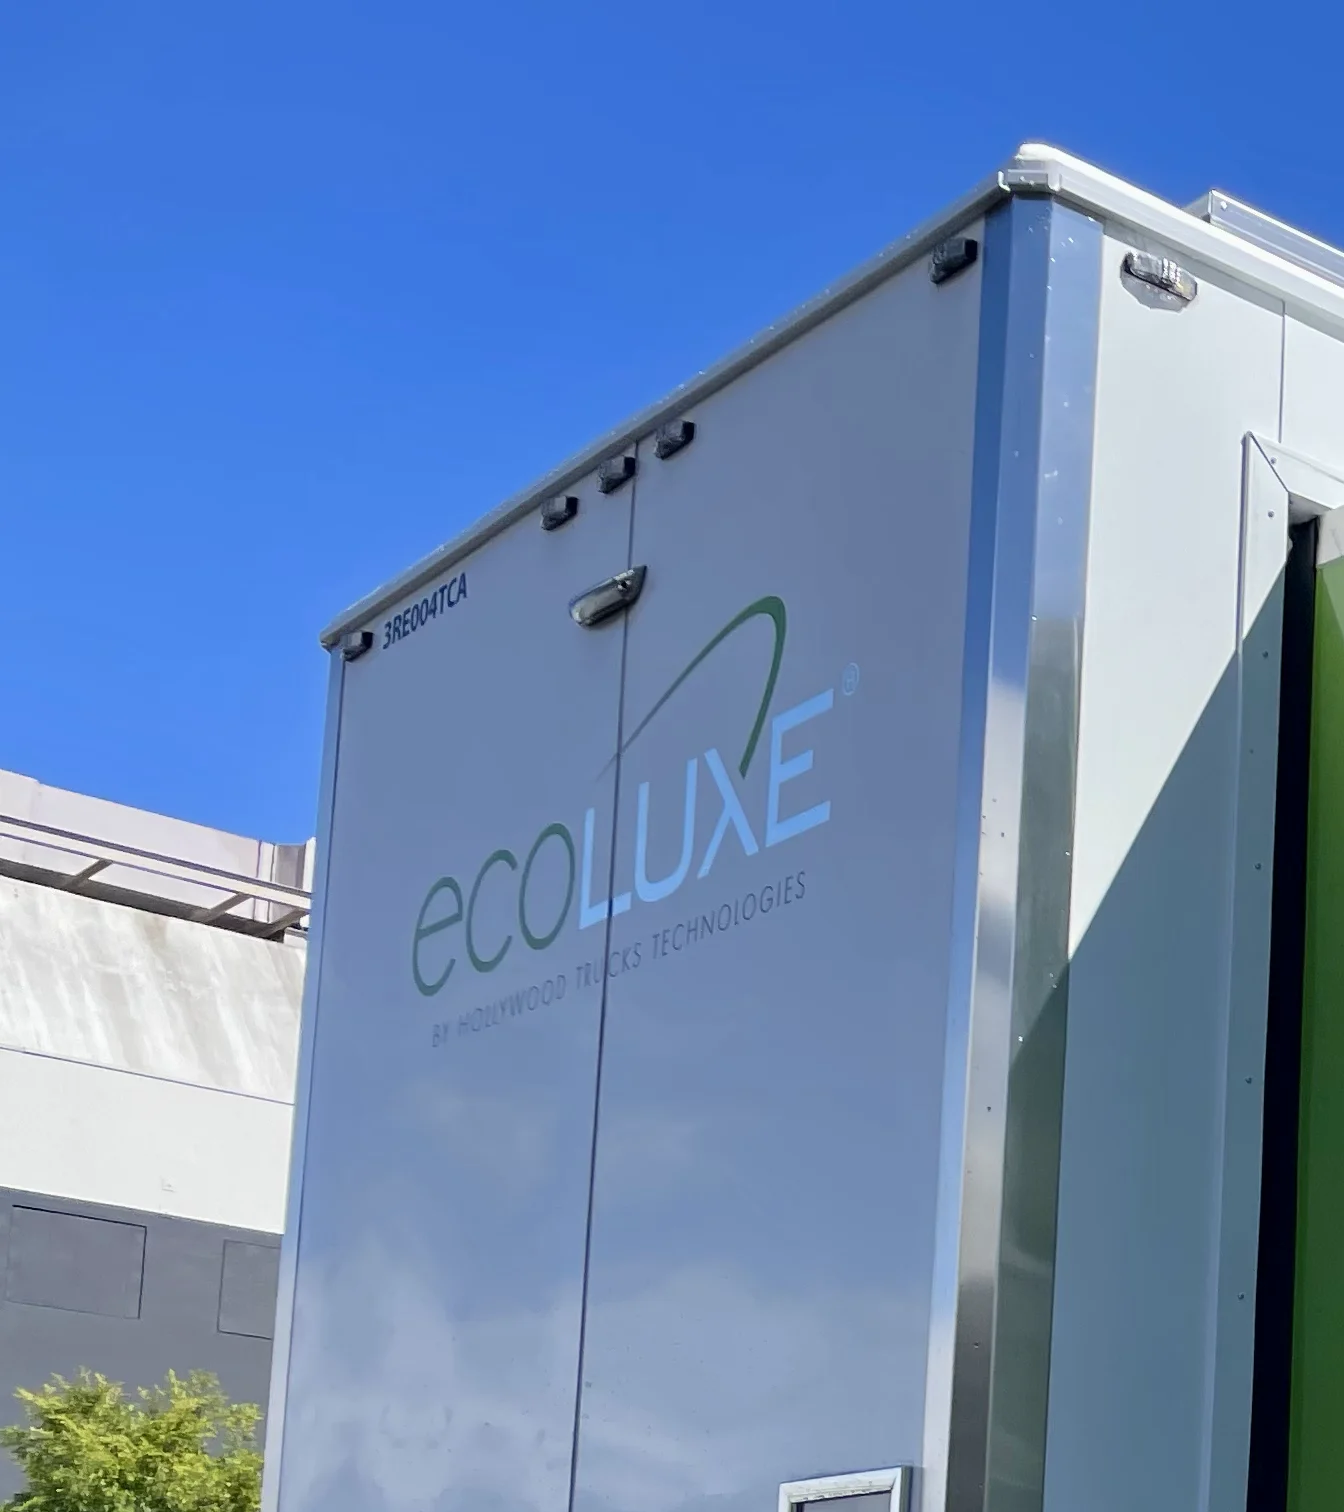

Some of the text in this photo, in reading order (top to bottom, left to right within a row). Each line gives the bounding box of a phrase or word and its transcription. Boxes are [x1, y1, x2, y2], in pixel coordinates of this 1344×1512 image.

[383, 572, 467, 650] 3RE004TCA
[432, 871, 806, 1048] BY HOLLYWOOD TRUCKS TECHNOLOGIES
